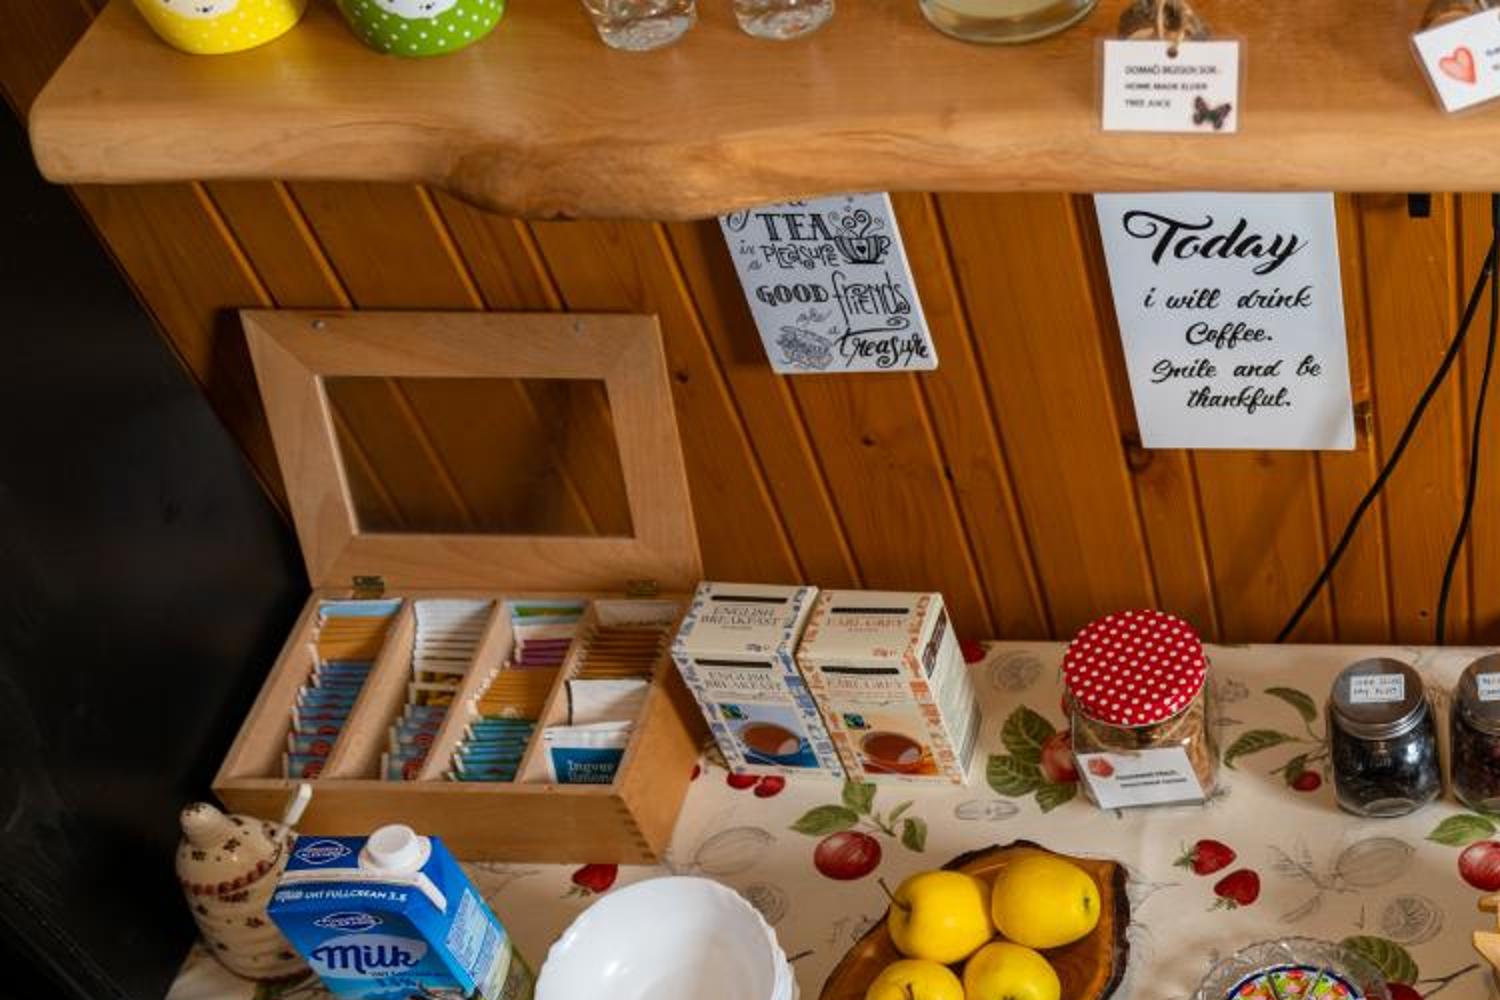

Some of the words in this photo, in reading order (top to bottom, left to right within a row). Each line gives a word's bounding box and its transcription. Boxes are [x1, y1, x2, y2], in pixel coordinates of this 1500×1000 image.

[755, 213, 836, 241] TEA
[1123, 210, 1308, 275] Today
[756, 284, 830, 306] GOOD
[1166, 288, 1221, 309] will
[1237, 285, 1313, 309] drink
[1186, 322, 1273, 349] Coffee.
[1152, 359, 1217, 383] Smile
[1233, 360, 1284, 377] and
[1296, 355, 1323, 377] be
[1187, 385, 1292, 415] thankful.
[701, 616, 781, 626] BREAKFAST
[712, 607, 775, 617] ENGLISH
[311, 945, 420, 974] Milk
